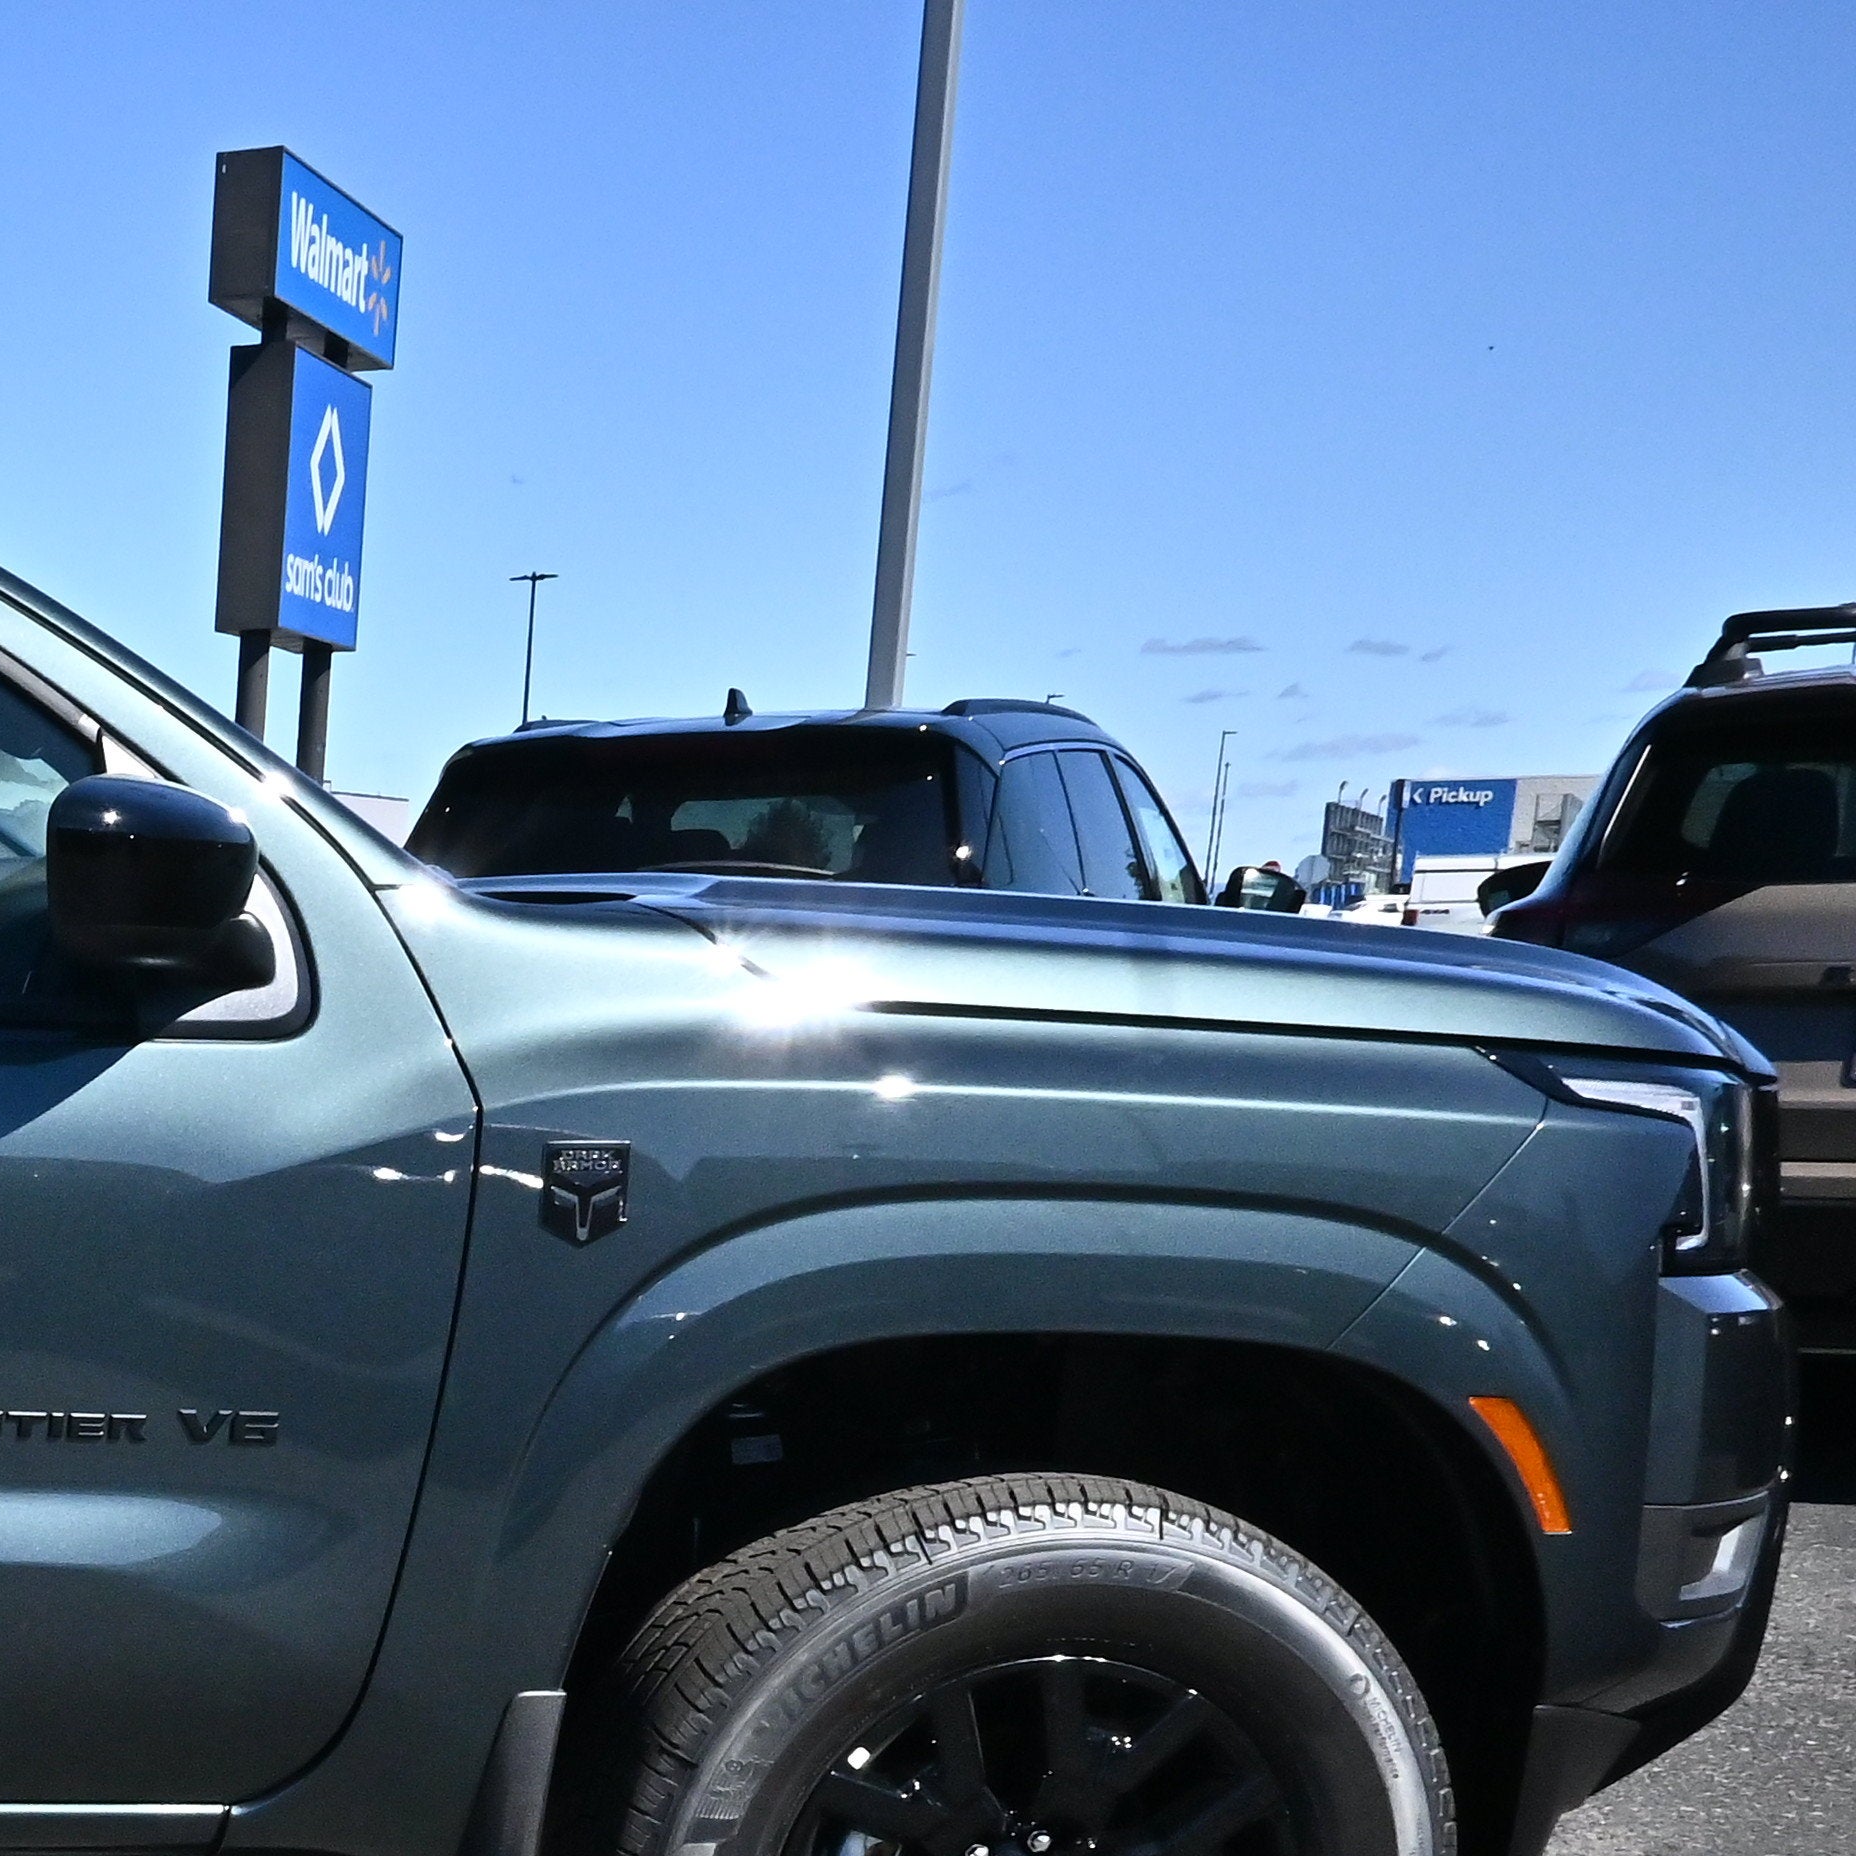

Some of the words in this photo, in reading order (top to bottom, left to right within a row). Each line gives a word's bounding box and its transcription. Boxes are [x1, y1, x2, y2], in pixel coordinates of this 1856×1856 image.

[291, 192, 369, 313] Walmart
[285, 551, 322, 603] sam's
[324, 561, 354, 612] club
[1429, 786, 1494, 807] Pickup
[553, 1160, 621, 1171] ARMOR
[559, 1149, 614, 1160] DARK
[177, 1408, 280, 1445] V6
